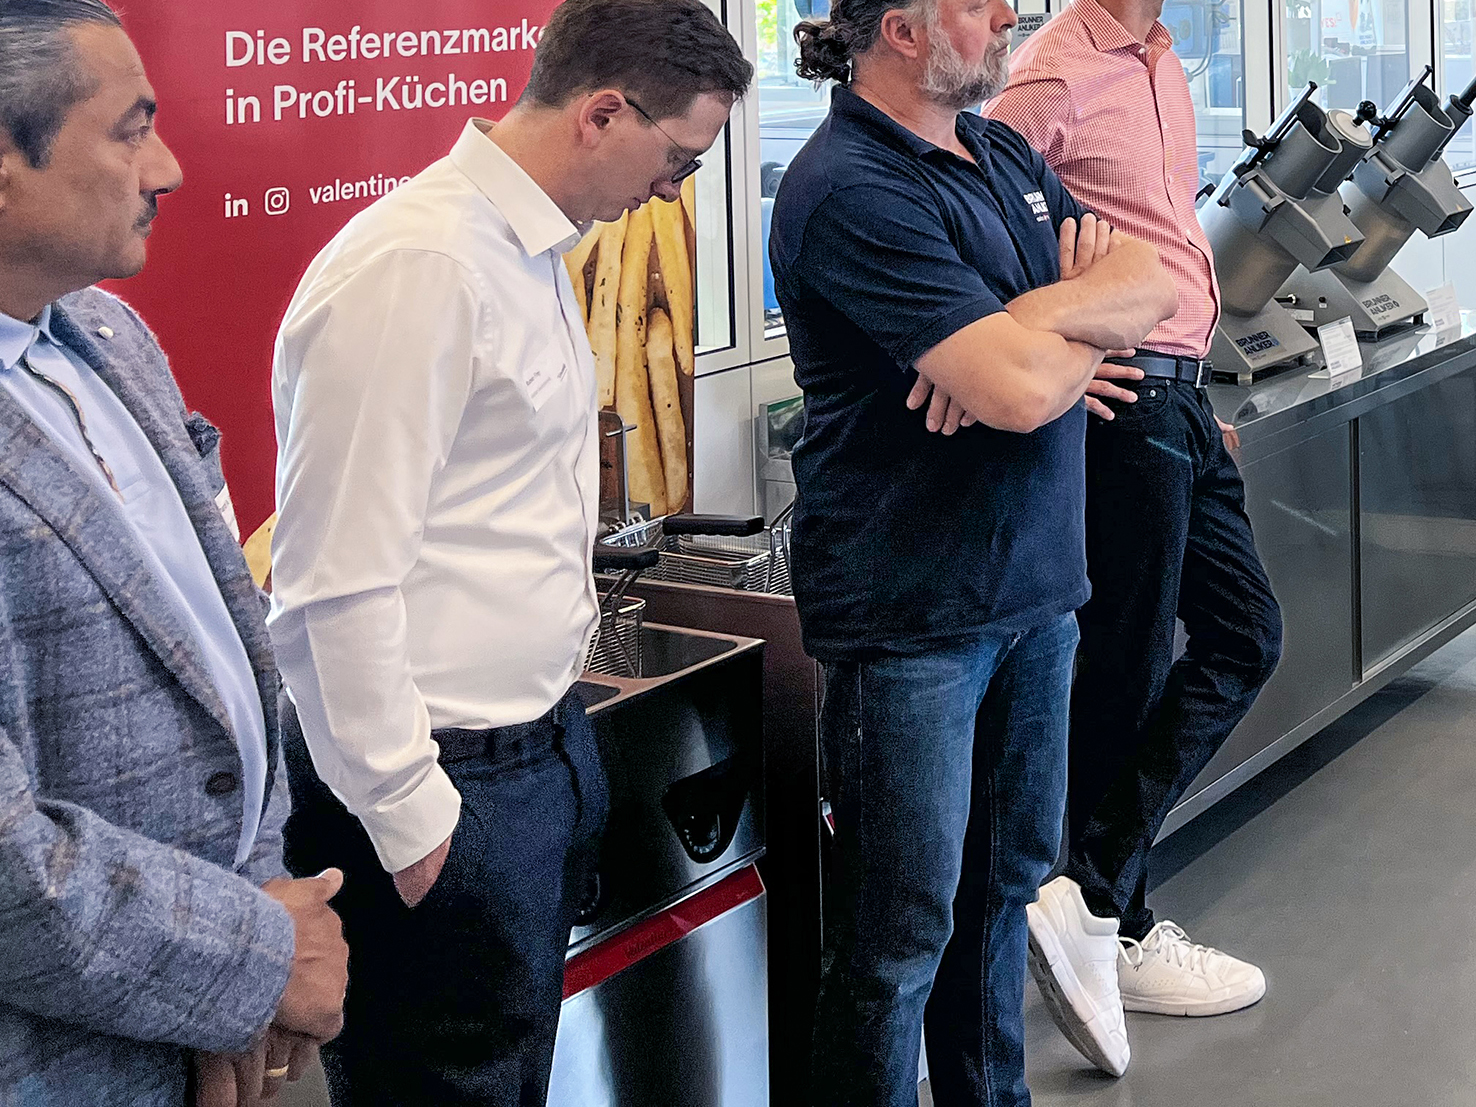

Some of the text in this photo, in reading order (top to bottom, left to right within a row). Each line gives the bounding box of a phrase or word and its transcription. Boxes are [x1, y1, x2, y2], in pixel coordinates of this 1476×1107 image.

[226, 30, 290, 66] Die
[226, 74, 507, 124] in Profi-Küchen
[1235, 330, 1271, 347] BRUNNER
[1243, 339, 1275, 355] ANLIKER
